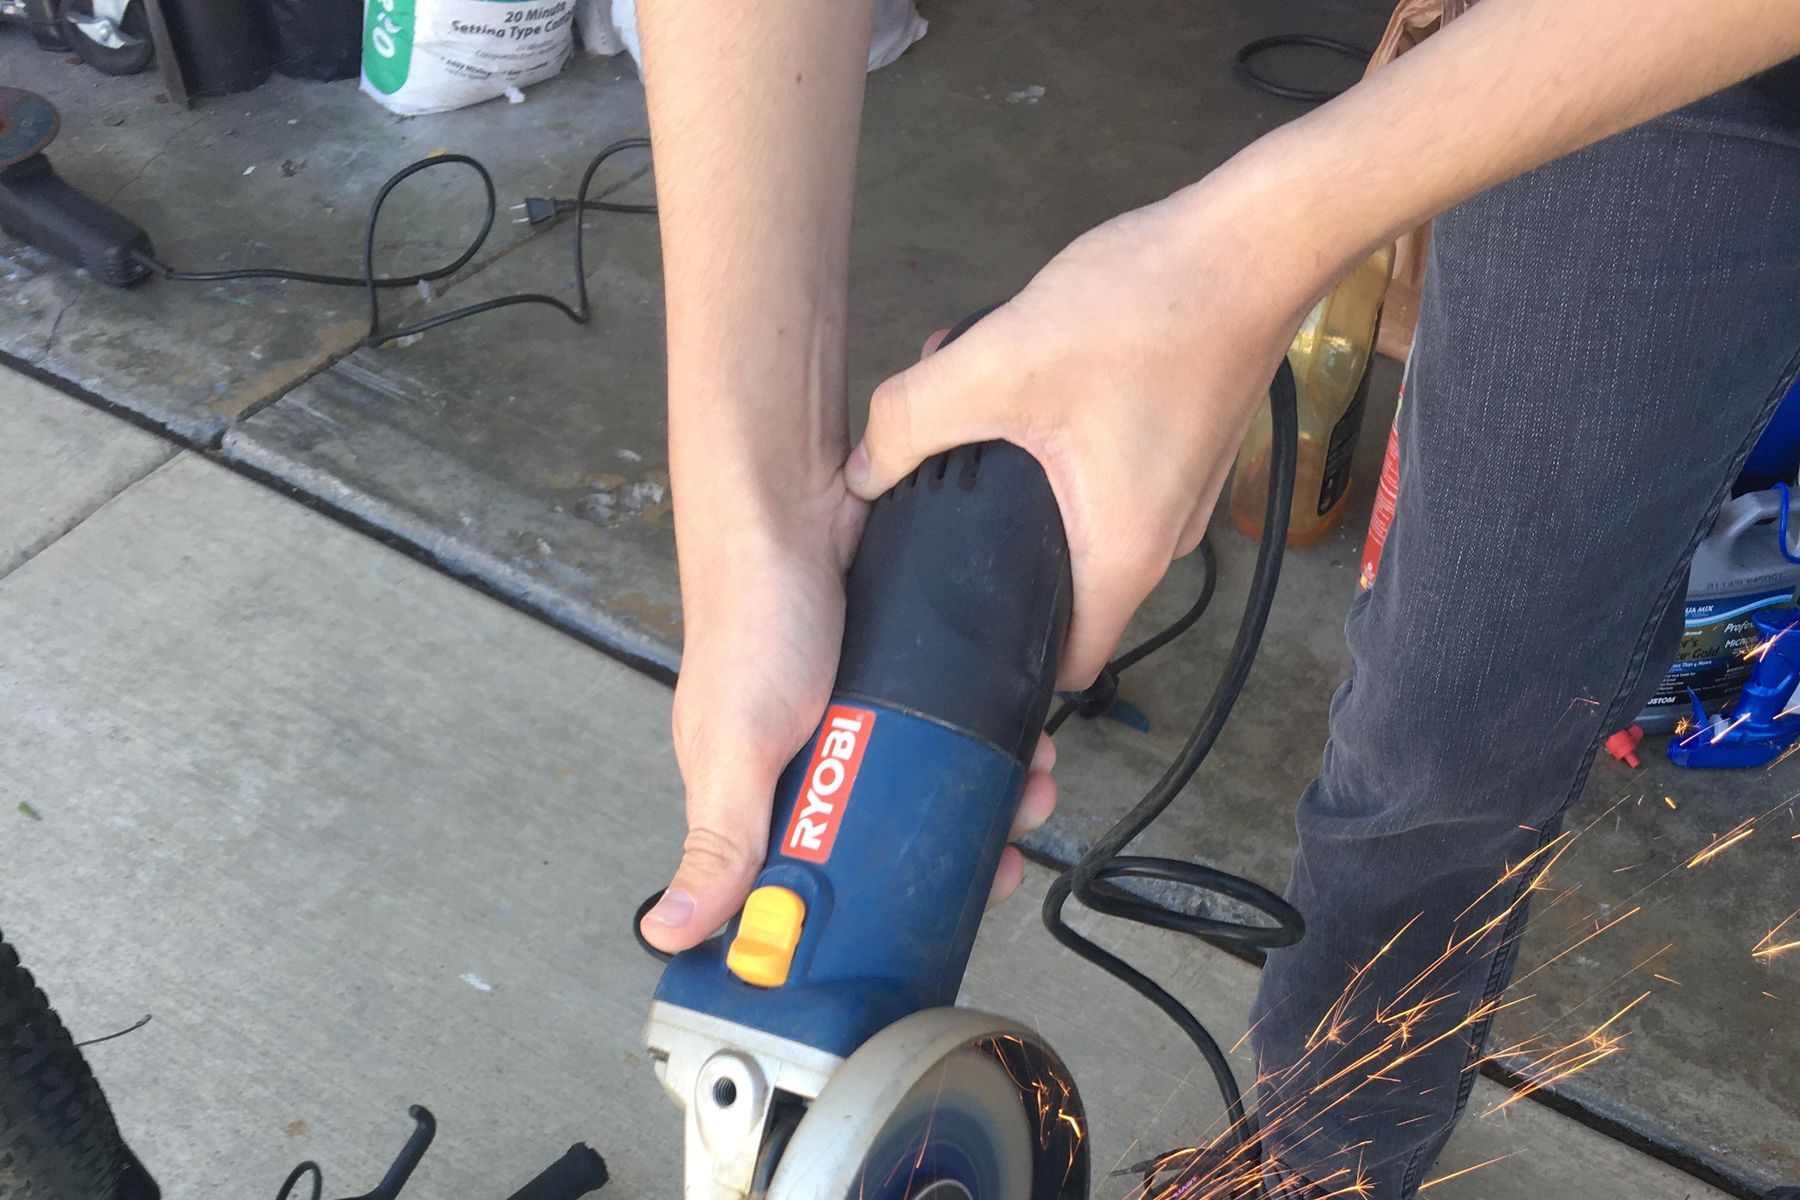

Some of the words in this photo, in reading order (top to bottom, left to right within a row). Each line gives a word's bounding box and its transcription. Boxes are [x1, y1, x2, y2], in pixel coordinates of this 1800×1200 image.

[504, 11, 522, 23] 20
[525, 1, 566, 20] Minute
[452, 20, 505, 38] Setting
[509, 25, 541, 40] Type
[1697, 605, 1714, 613] MIX
[1692, 646, 1720, 659] Gold
[1648, 696, 1676, 705] USTOM
[790, 717, 862, 850] RYOBI
